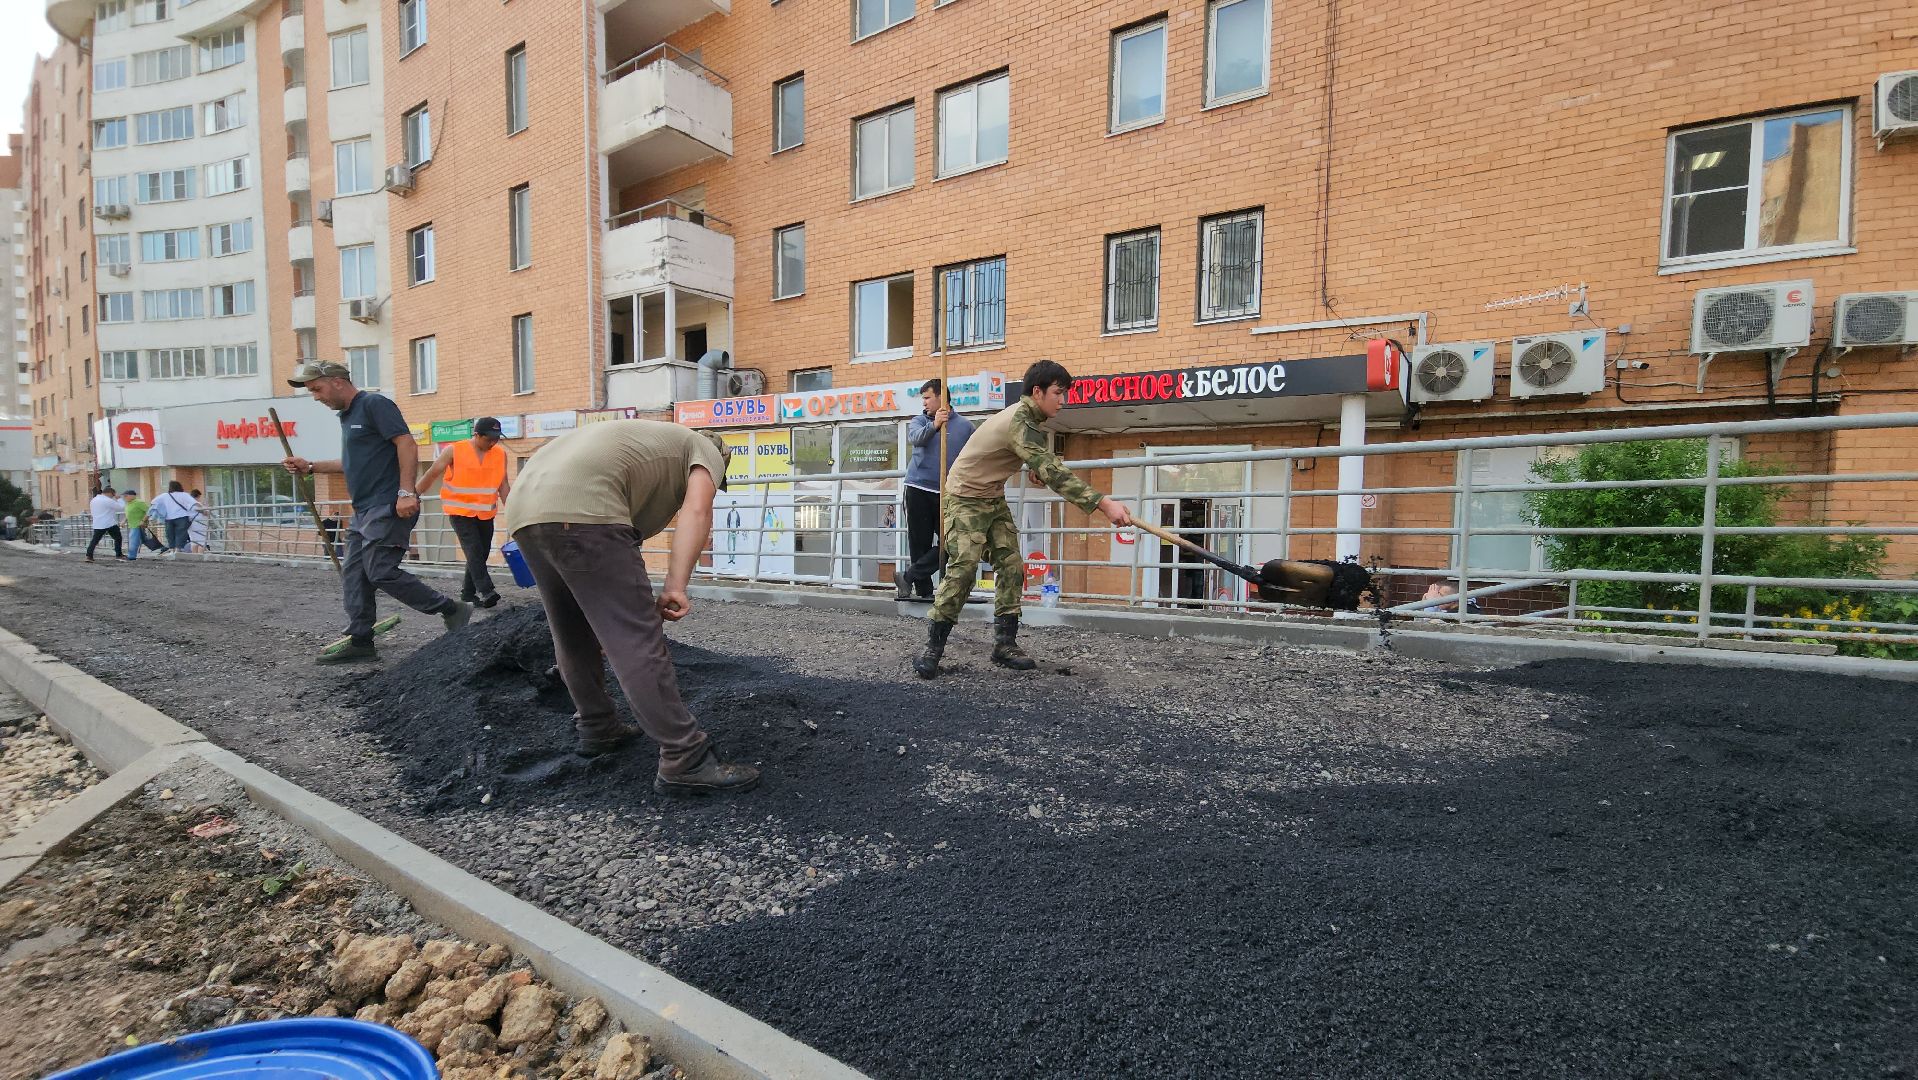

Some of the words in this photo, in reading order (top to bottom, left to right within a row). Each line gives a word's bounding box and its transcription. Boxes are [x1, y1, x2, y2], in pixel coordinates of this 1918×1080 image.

[713, 399, 767, 417] ОБУВЬ
[807, 389, 900, 417] ОРТЕКА
[757, 444, 789, 456] ОБУВЬ
